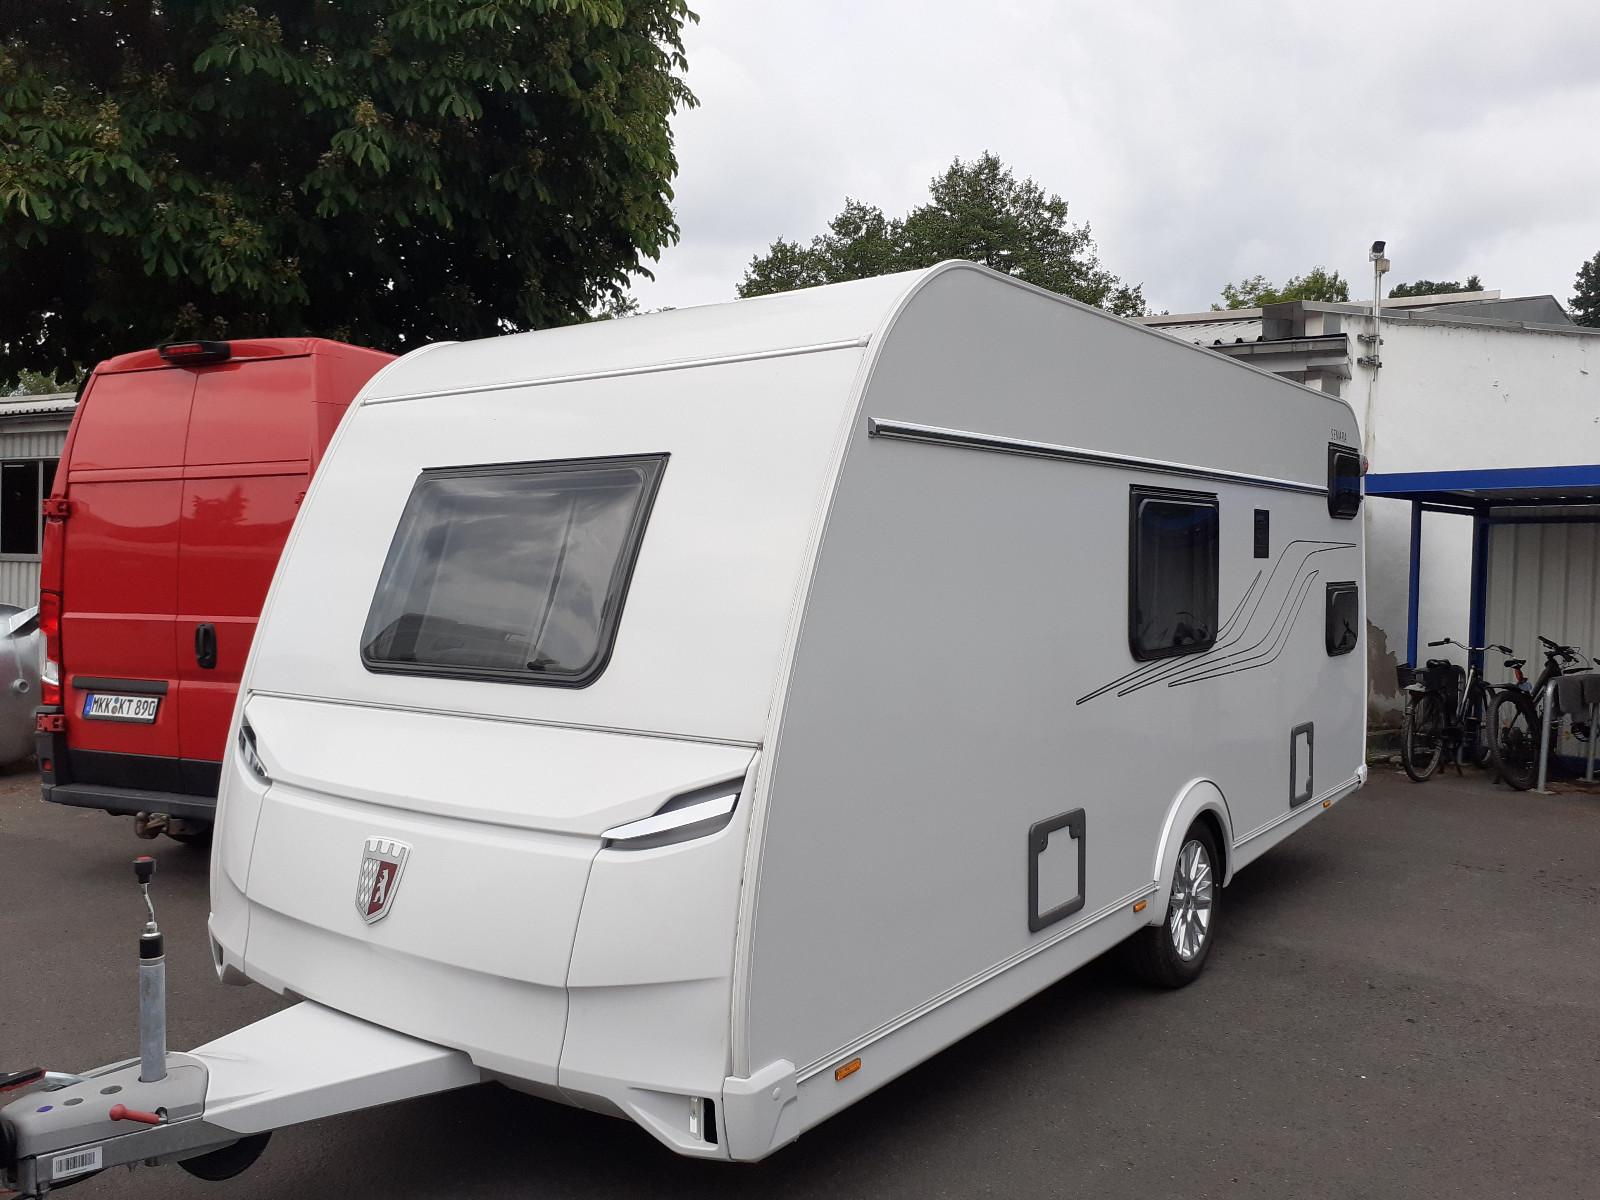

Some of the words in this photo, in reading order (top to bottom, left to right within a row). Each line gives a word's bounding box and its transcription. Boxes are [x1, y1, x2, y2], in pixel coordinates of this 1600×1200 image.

[91, 697, 112, 714] MKK
[118, 698, 134, 715] KT
[134, 700, 155, 717] 890
